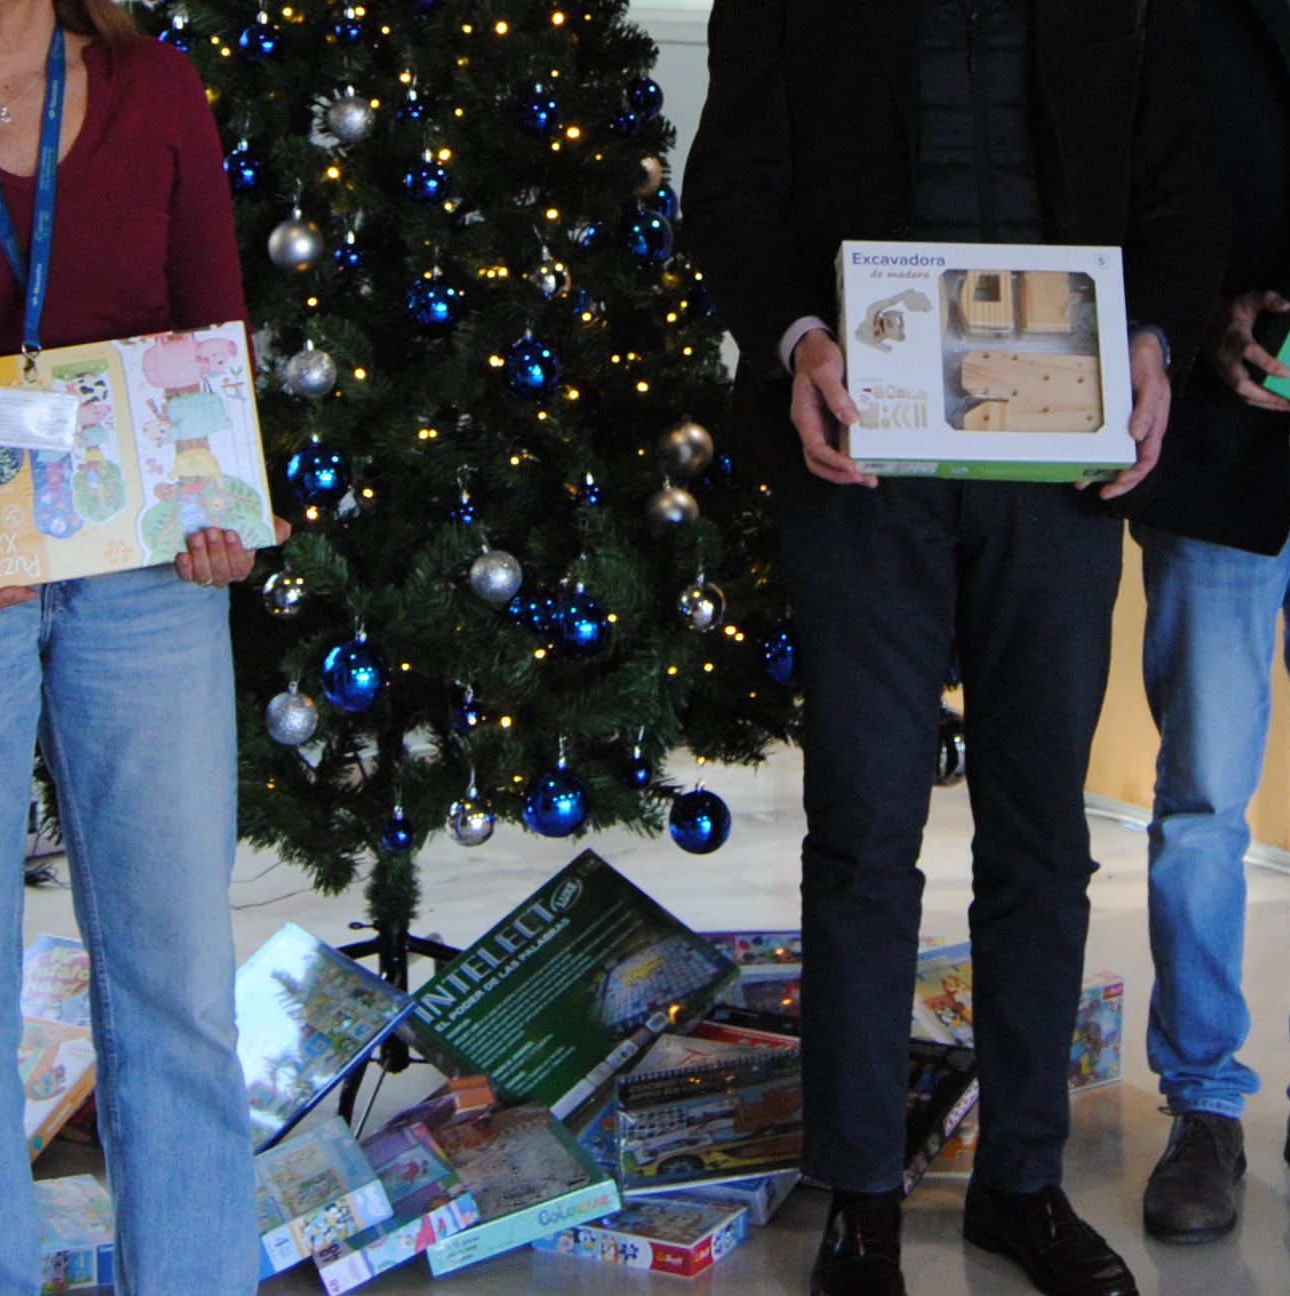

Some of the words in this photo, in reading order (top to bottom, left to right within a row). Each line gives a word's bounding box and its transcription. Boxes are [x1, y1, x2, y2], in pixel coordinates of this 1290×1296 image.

[852, 252, 946, 266] Excavadora
[870, 269, 884, 279] de
[887, 269, 930, 280] madera
[414, 899, 555, 1025] INTELECT
[435, 1021, 451, 1034] EL
[449, 990, 485, 1021] PODER
[483, 977, 500, 992] DE
[498, 959, 521, 979] LAS
[519, 917, 572, 961] PALABRAS
